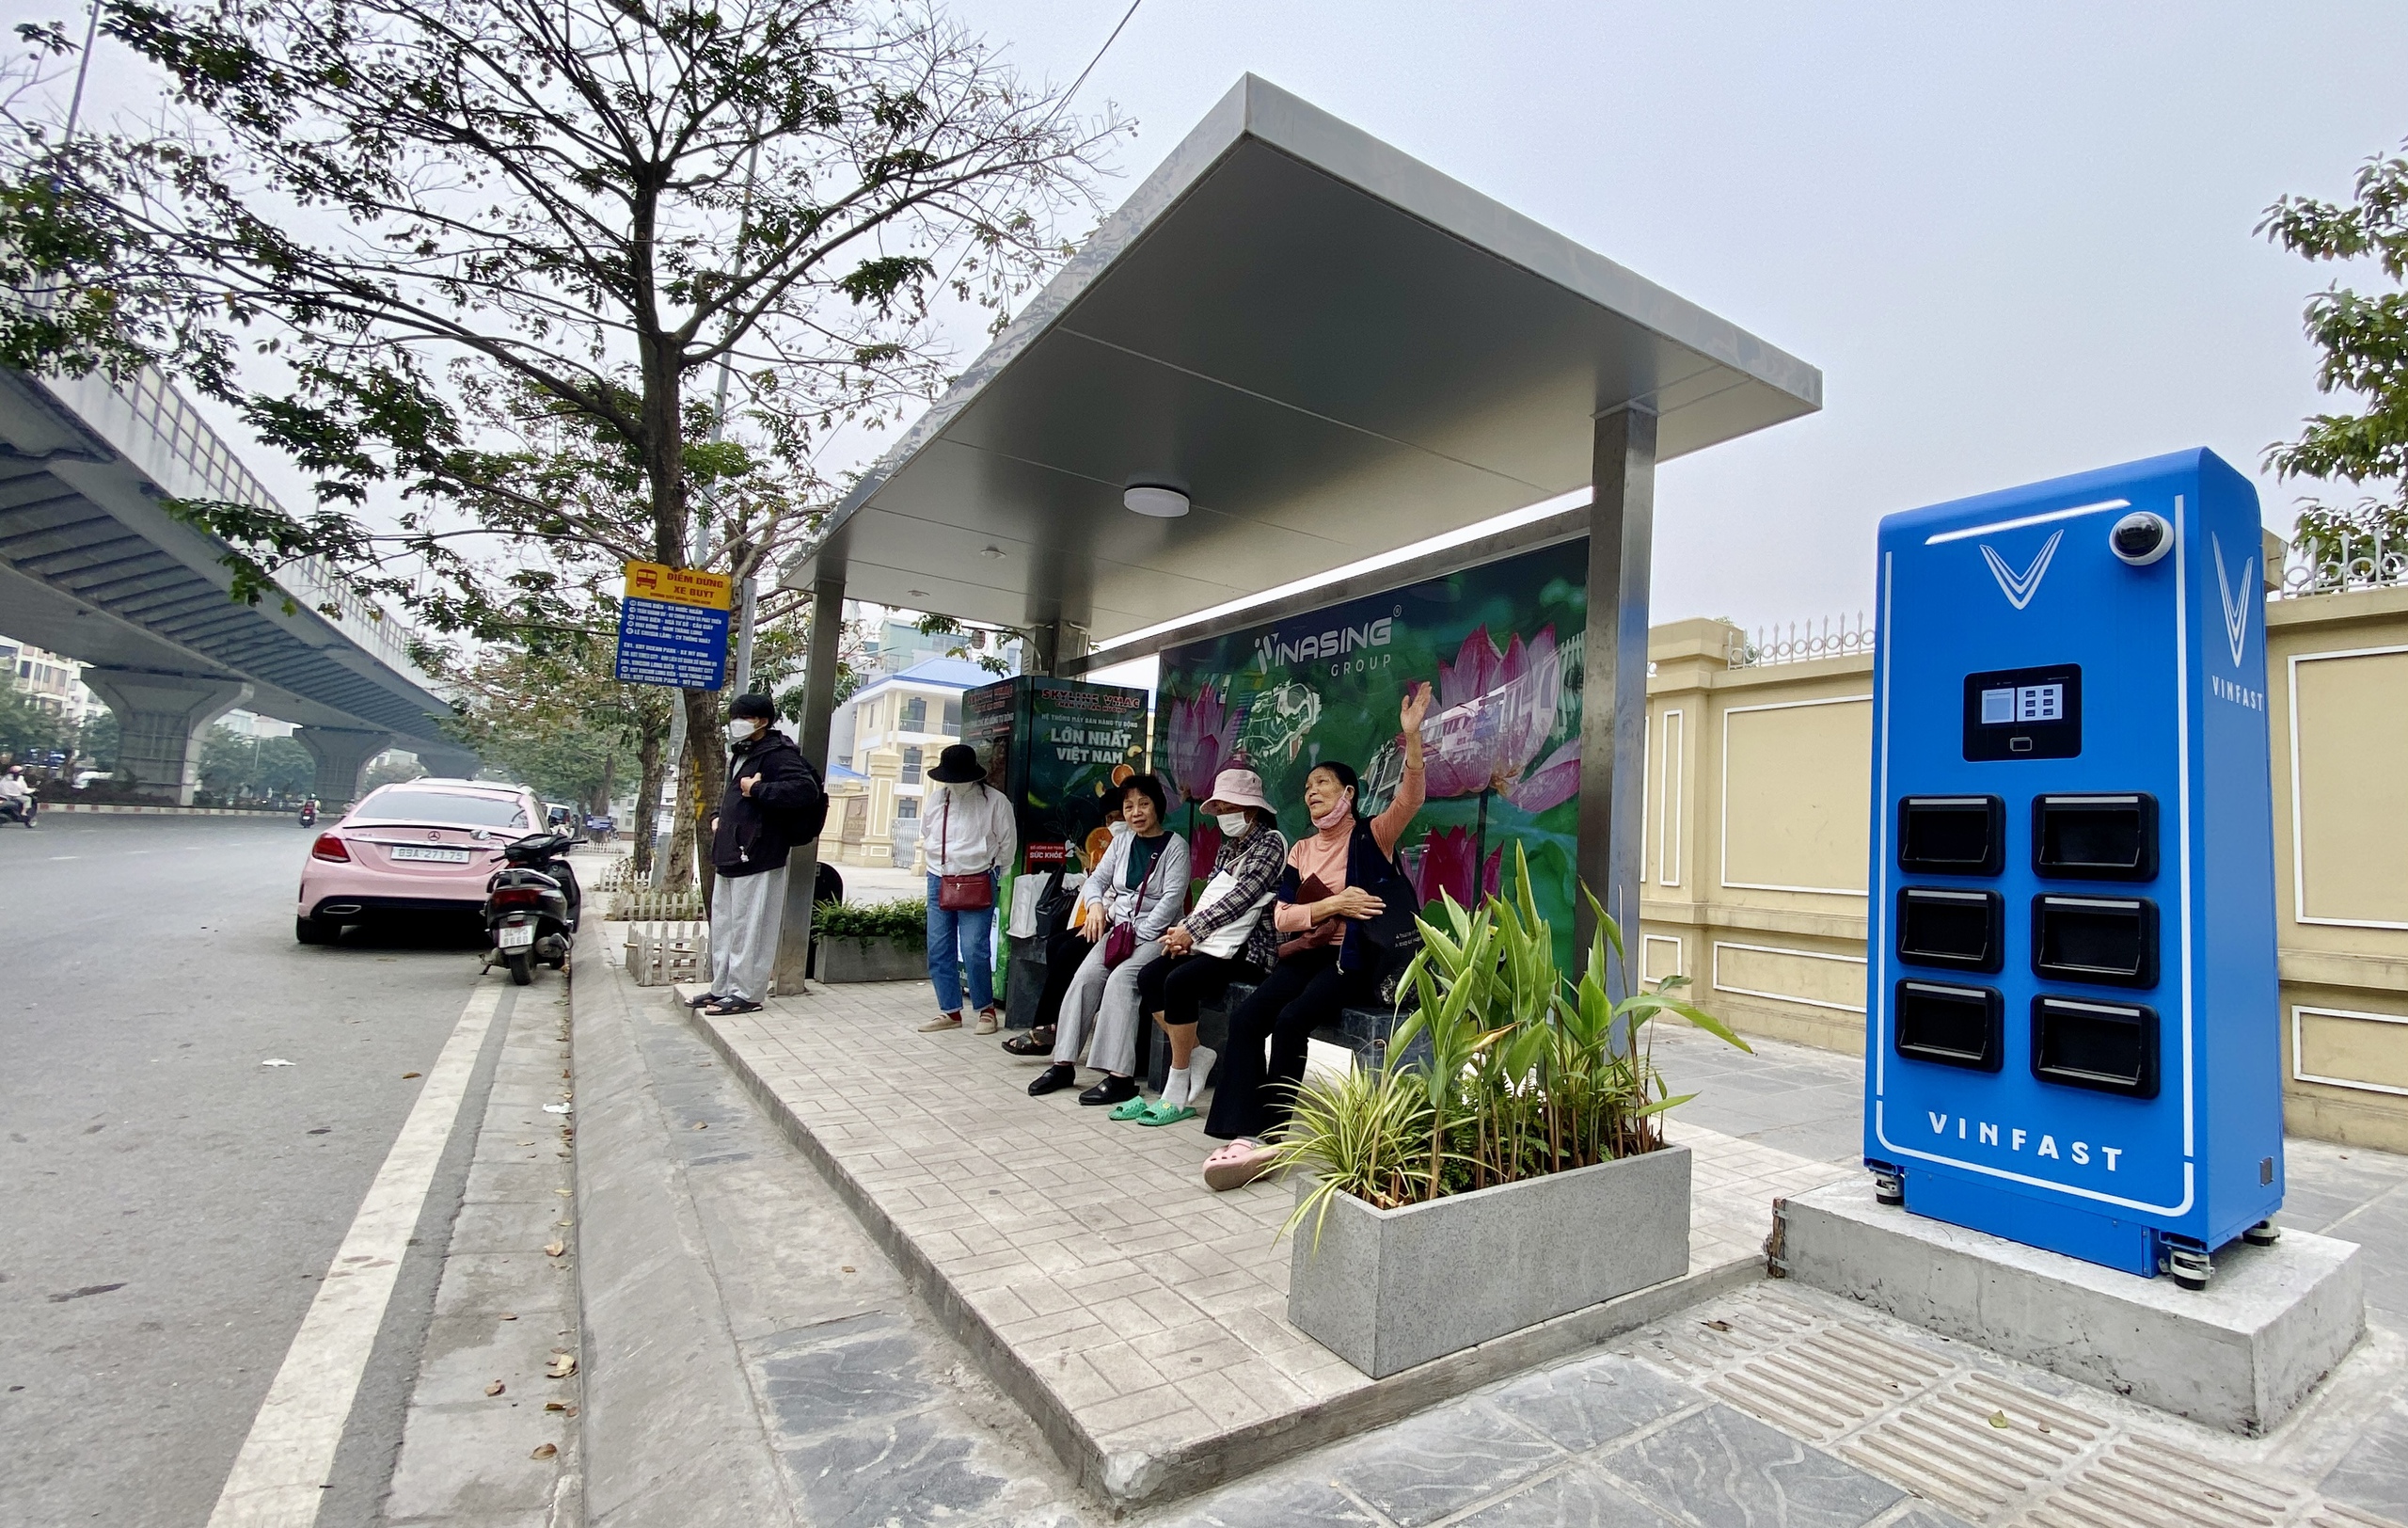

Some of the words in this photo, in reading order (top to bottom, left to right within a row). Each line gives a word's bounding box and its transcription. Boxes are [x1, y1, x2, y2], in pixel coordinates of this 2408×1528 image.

[673, 585, 687, 595] XE
[1331, 654, 1390, 677] GROUP
[1041, 689, 1099, 705] SKYLINE
[2212, 676, 2263, 712] VINFAST
[1050, 725, 1085, 745] LỚN
[1087, 728, 1133, 749] NHẤT
[1055, 745, 1089, 764] VIỆT
[1091, 750, 1123, 764] NAM
[1928, 1111, 2122, 1172] VINFAST
